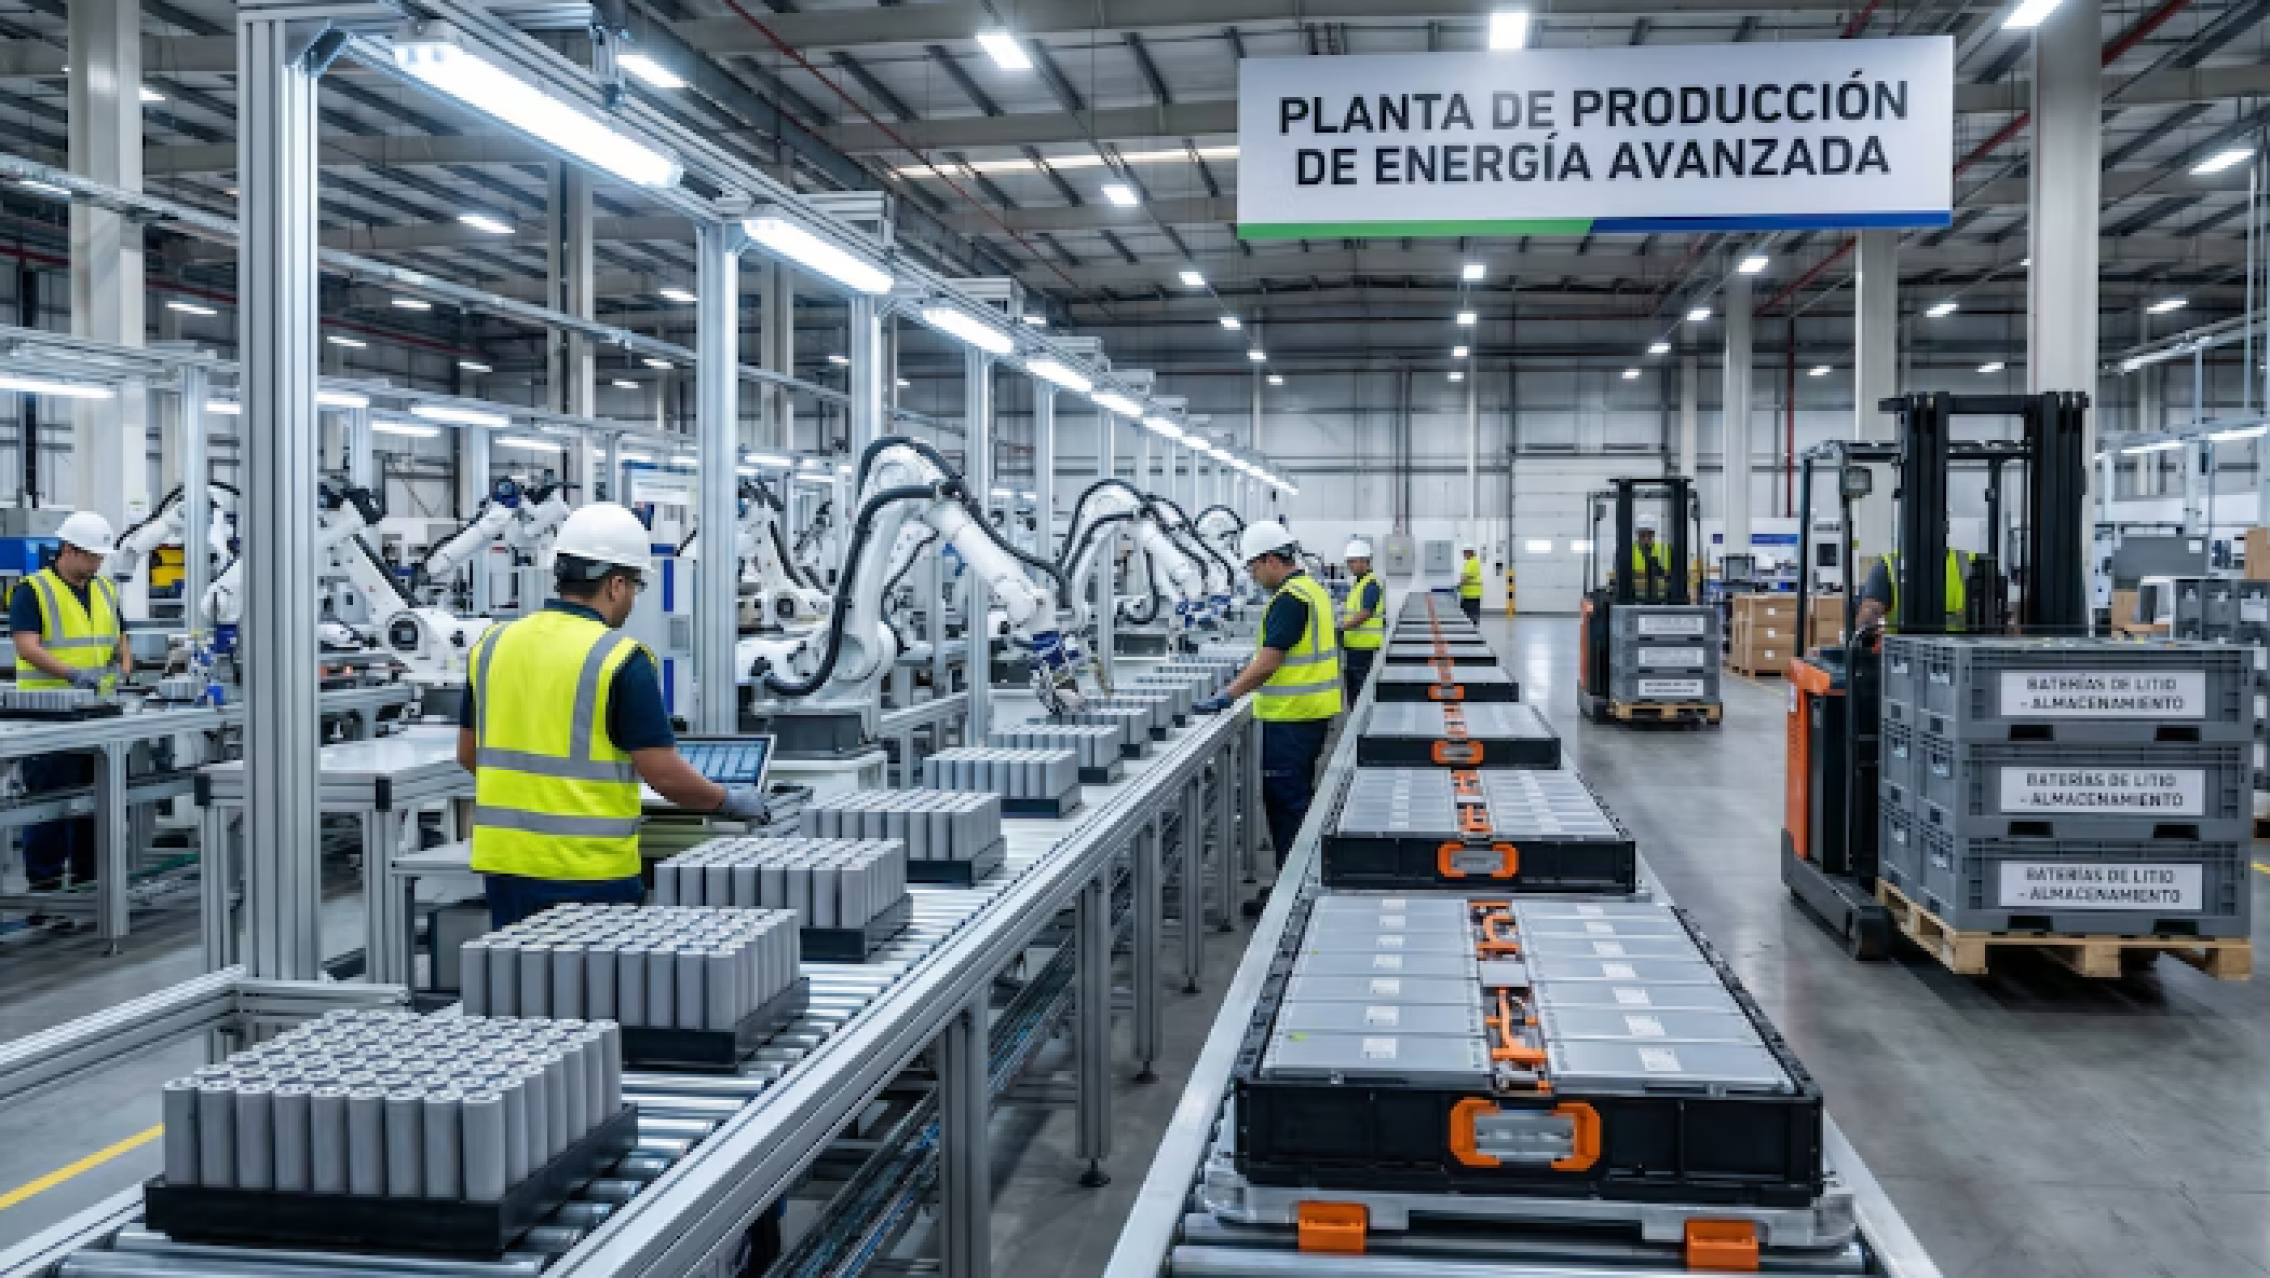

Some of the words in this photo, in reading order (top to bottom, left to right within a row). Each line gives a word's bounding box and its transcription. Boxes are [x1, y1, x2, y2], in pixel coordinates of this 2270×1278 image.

[1279, 93, 1475, 134] PLANTA
[1491, 90, 1556, 130] DE
[1573, 69, 1908, 127] PRODUCCIÓN
[1296, 148, 1358, 186] DE
[1374, 131, 1593, 185] ENERGÍA
[1607, 135, 1891, 180] AVANZADA
[2111, 676, 2131, 691] DE
[2133, 676, 2177, 691] LITIO
[2108, 772, 2131, 788] DE
[2133, 772, 2177, 788] LITIO
[2107, 868, 2129, 884] DE
[2133, 869, 2175, 884] LITIO
